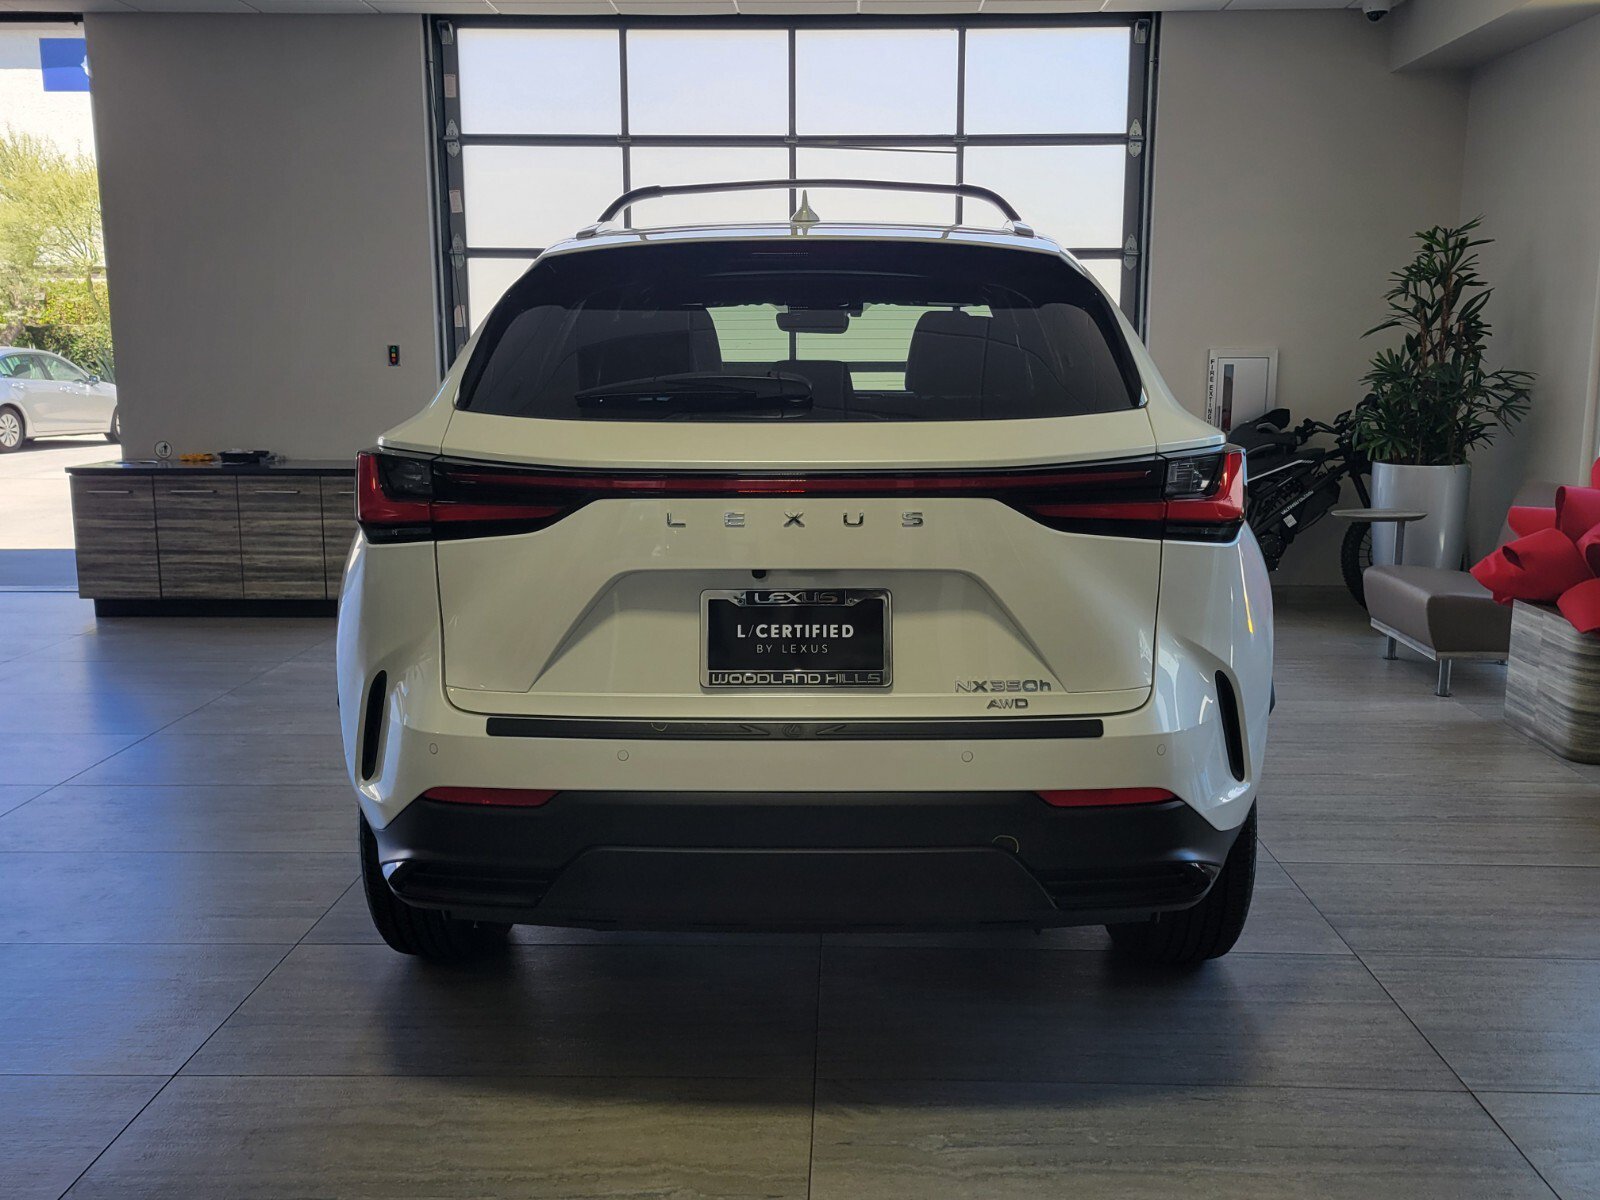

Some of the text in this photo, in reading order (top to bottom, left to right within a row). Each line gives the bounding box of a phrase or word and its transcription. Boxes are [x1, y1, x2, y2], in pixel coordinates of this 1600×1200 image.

[667, 512, 924, 528] LEXUS
[754, 592, 838, 604] LEXUS
[737, 624, 854, 638] L/CERTIFIED
[756, 644, 829, 653] BY LEXUS
[712, 673, 881, 684] WOODLAND HILLS
[955, 679, 1051, 693] NX350h
[986, 698, 1029, 709] AWD
